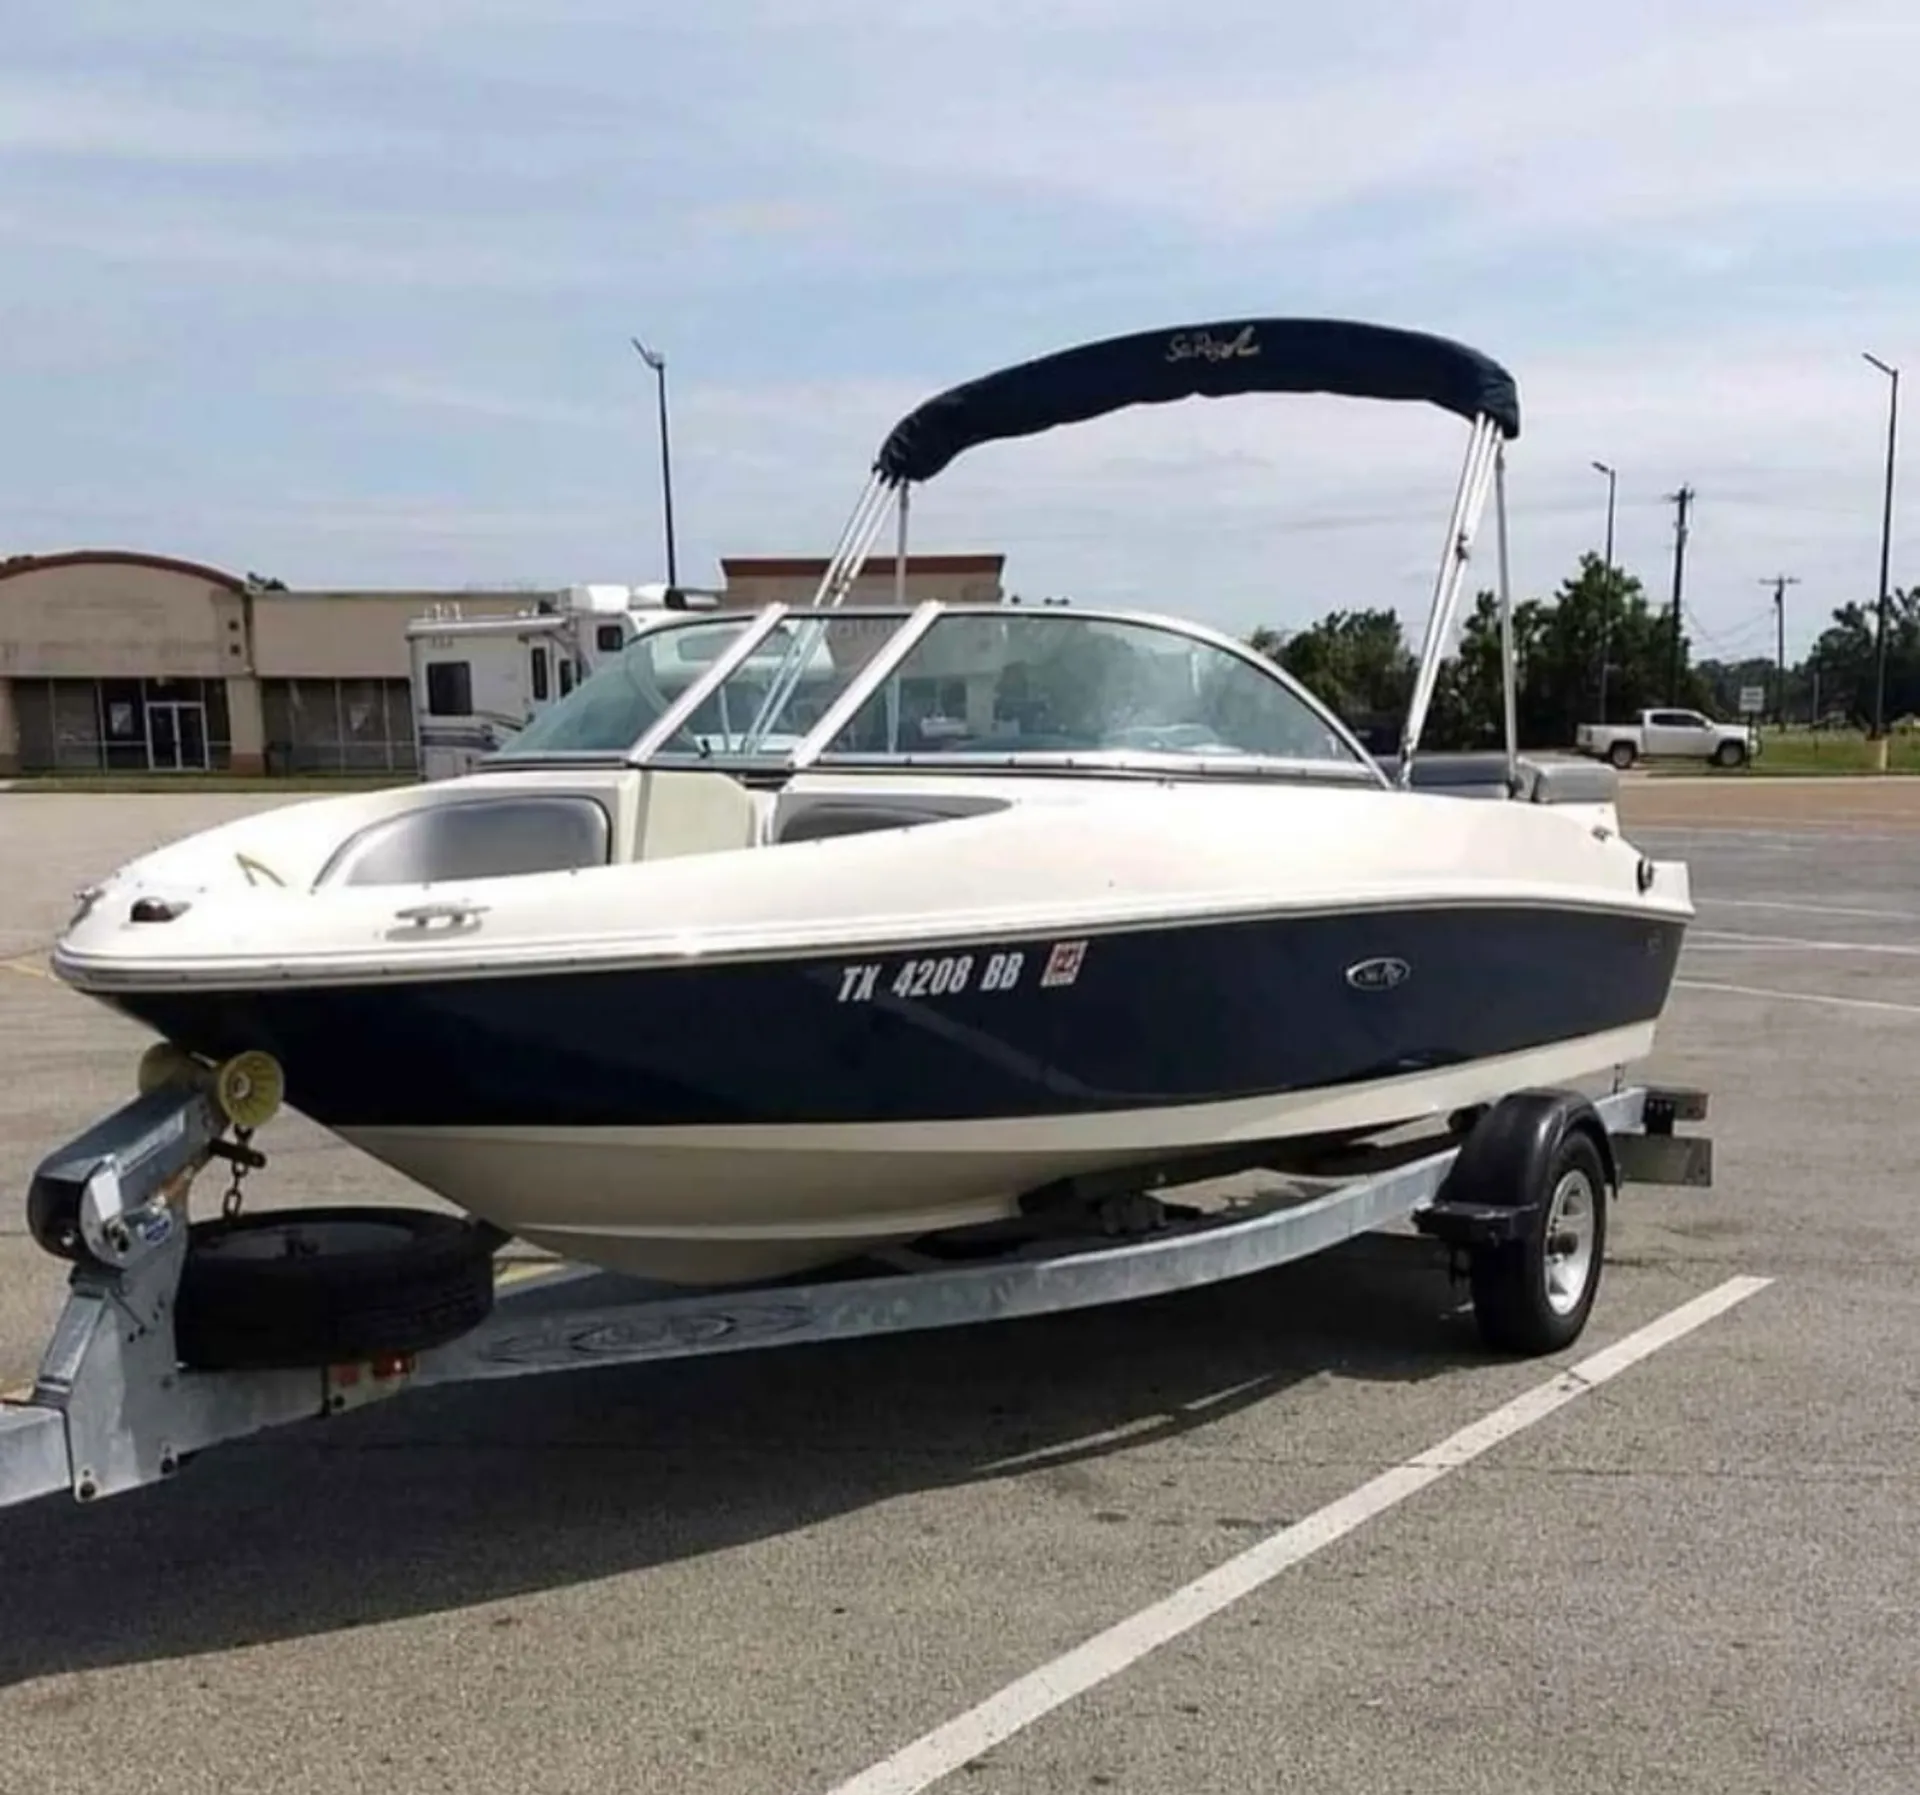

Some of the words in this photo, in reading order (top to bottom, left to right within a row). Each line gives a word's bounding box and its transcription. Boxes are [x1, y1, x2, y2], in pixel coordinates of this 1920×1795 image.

[838, 964, 881, 1002] TX
[892, 956, 973, 998] 4208
[980, 952, 1025, 991] BB
